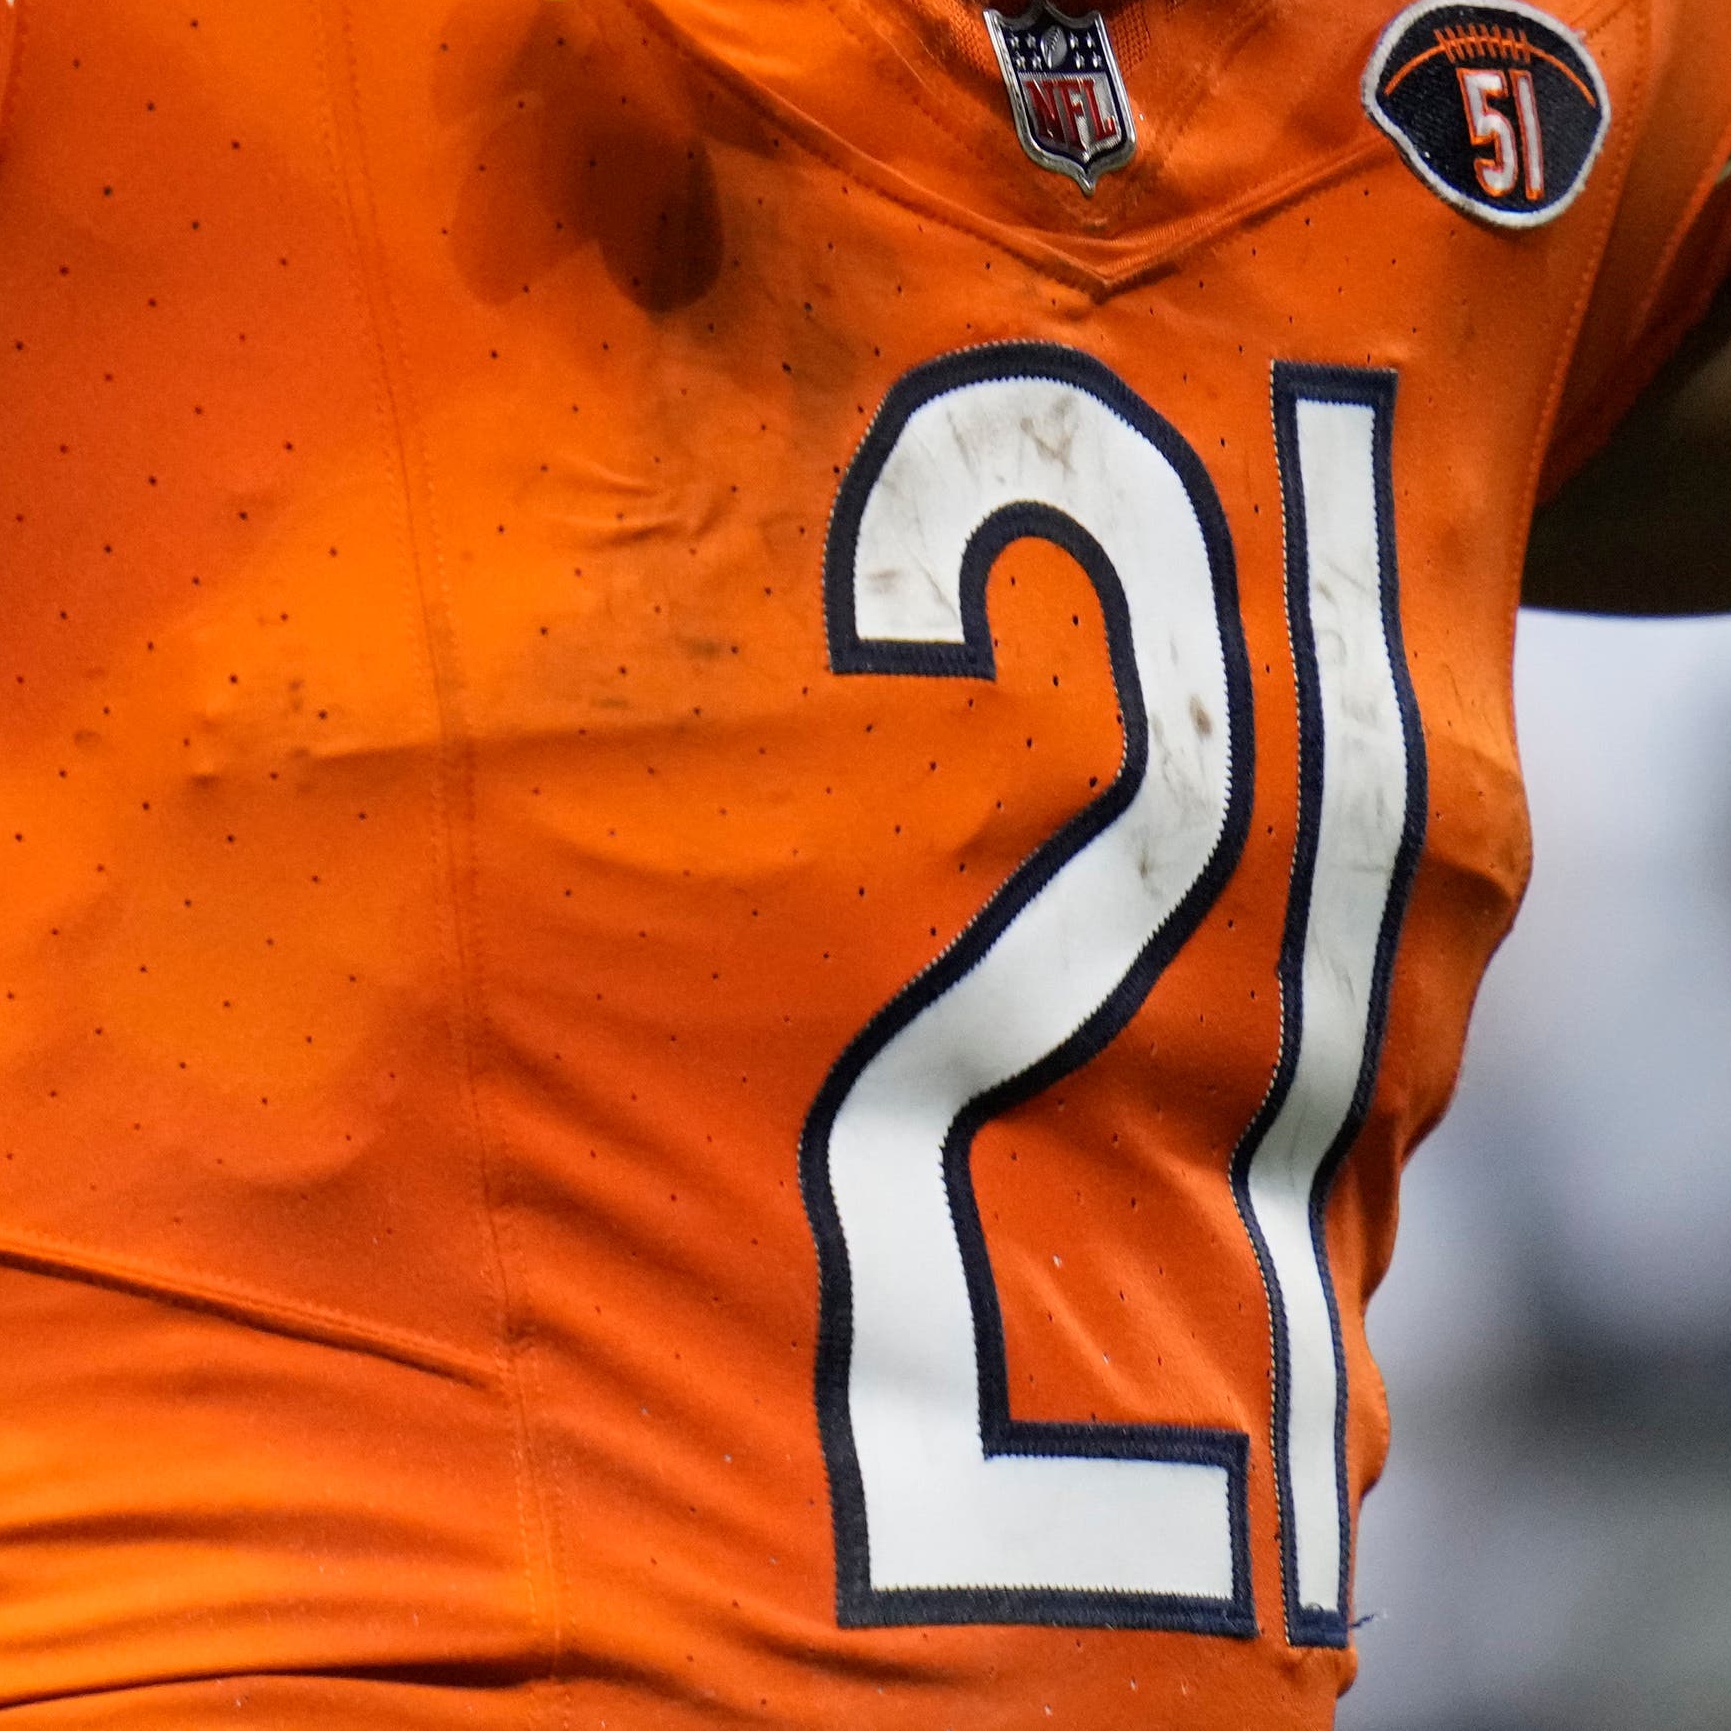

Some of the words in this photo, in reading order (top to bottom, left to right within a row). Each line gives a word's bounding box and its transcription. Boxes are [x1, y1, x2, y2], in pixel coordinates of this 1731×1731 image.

[1025, 78, 1118, 150] NFL
[1456, 68, 1545, 201] 51
[798, 341, 1428, 1648] 21
